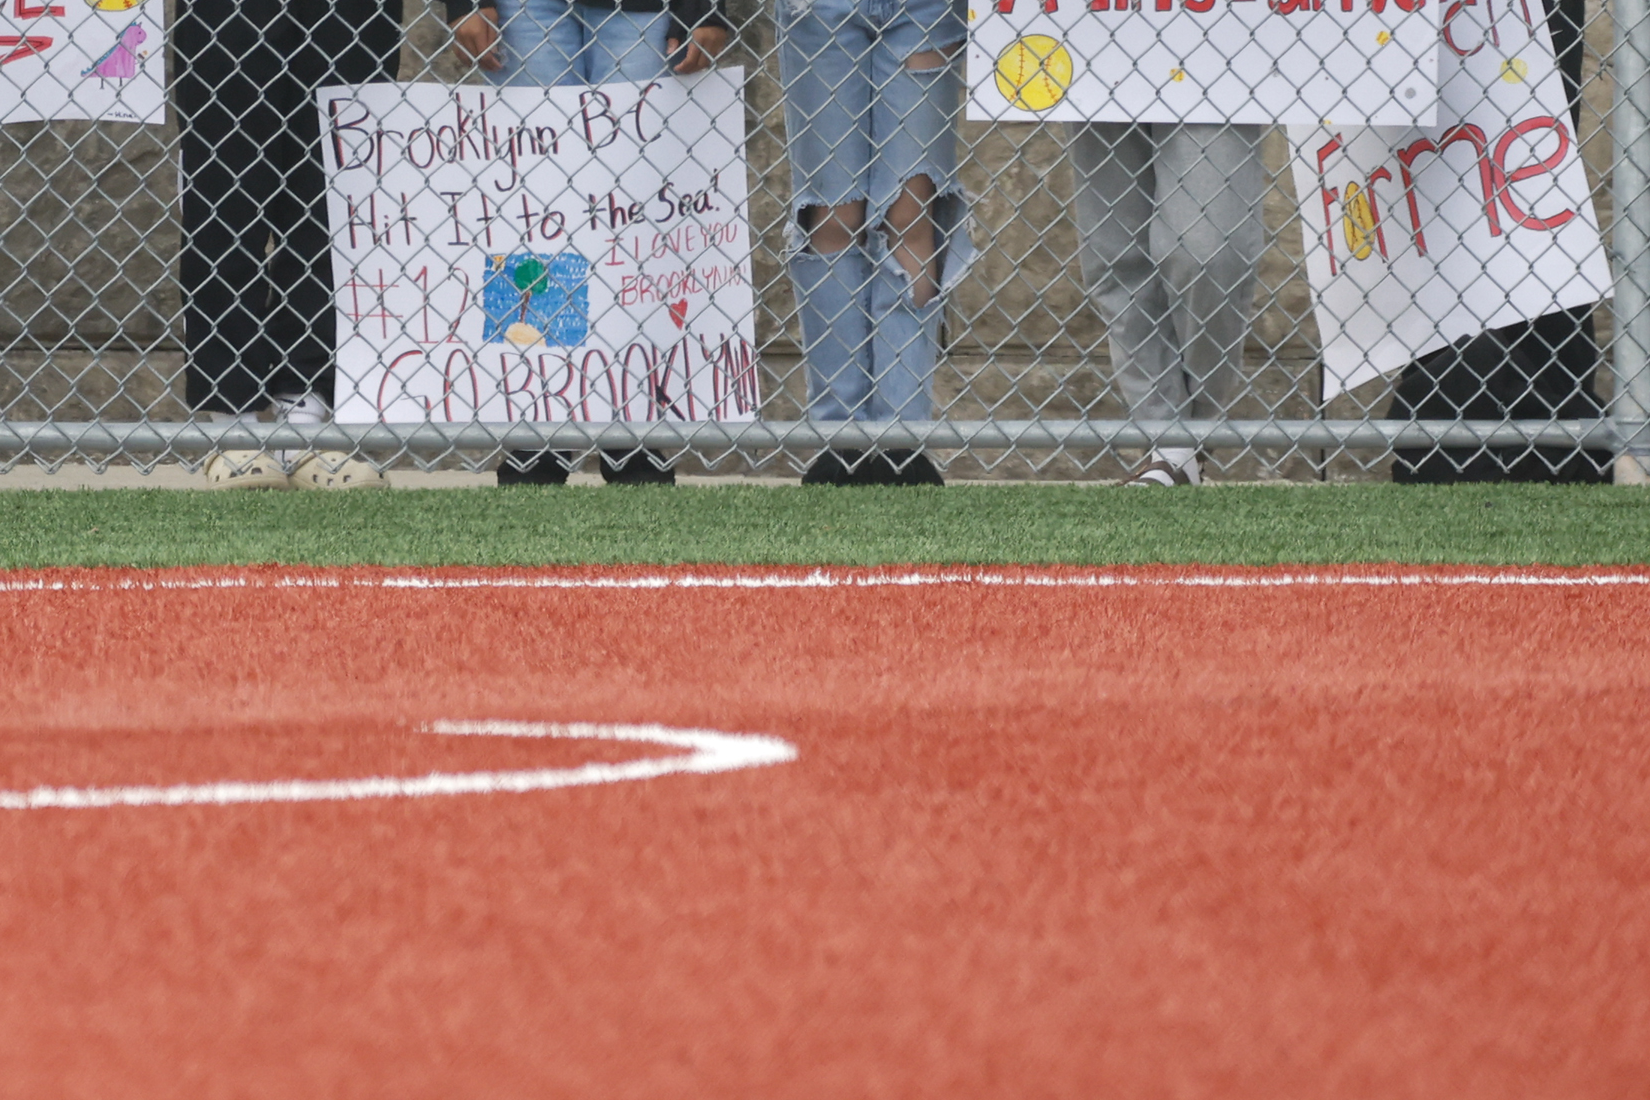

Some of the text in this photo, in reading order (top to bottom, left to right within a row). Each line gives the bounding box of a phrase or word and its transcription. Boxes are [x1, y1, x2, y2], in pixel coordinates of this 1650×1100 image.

[328, 92, 559, 192] Brooklynn
[347, 192, 418, 249] Hit
[440, 192, 496, 247] It
[516, 193, 565, 241] to
[582, 191, 646, 231] the
[604, 236, 625, 267] I
[700, 221, 738, 248] YOU
[343, 264, 470, 345] #12
[377, 348, 478, 421] GO
